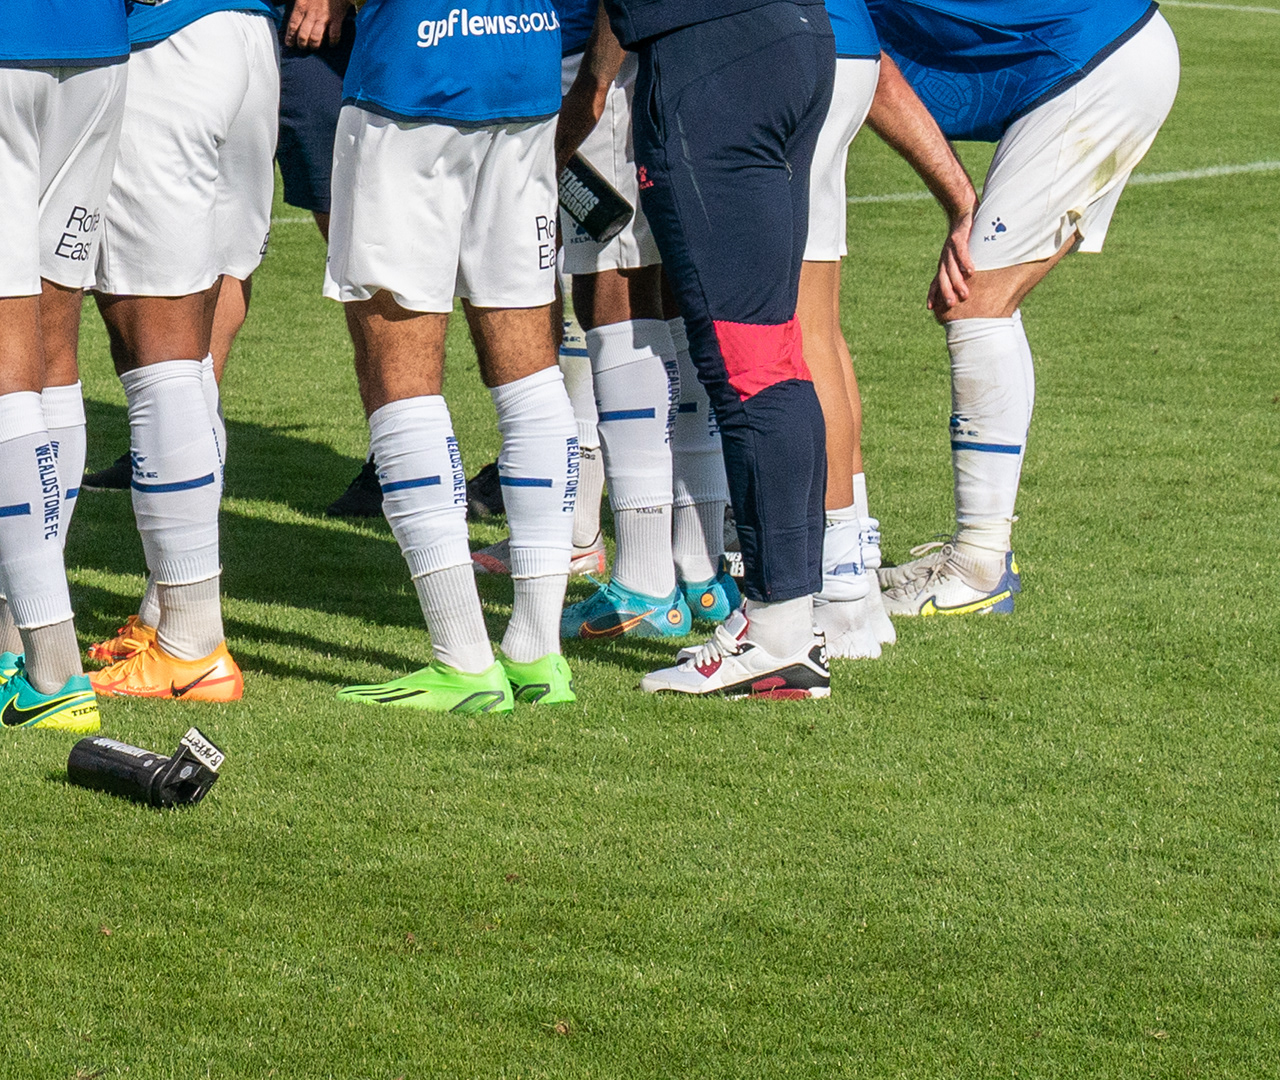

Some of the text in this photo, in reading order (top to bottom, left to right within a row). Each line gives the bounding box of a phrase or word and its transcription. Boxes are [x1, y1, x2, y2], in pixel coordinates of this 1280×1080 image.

[35, 443, 60, 524] WEALDSTONE
[445, 435, 465, 493] WEALDSTONE
[564, 436, 579, 499] WEALDSTONE
[44, 522, 60, 540] FC
